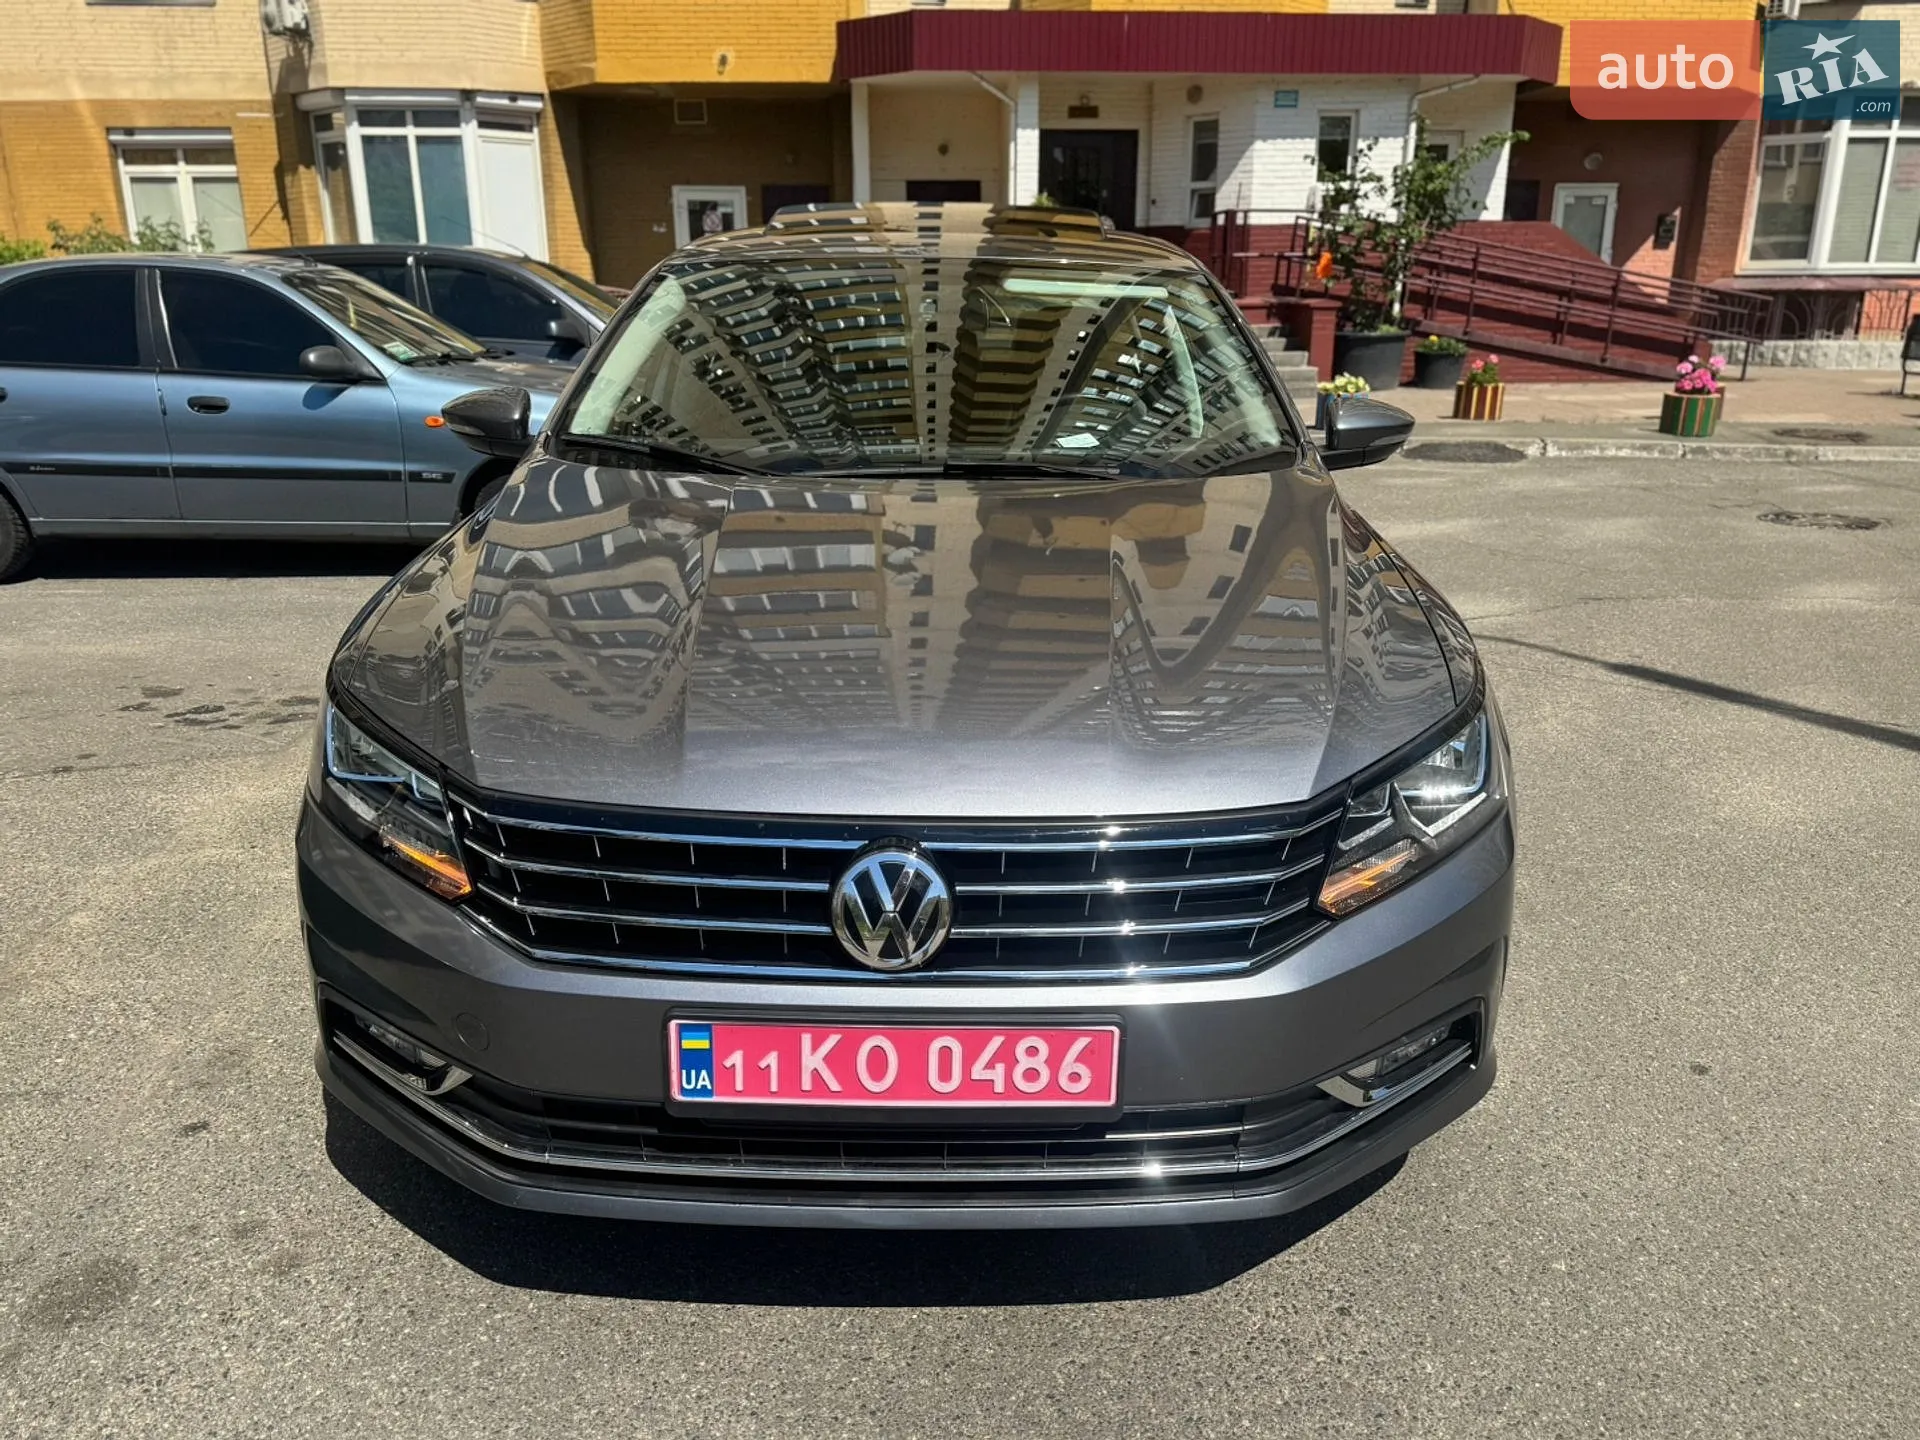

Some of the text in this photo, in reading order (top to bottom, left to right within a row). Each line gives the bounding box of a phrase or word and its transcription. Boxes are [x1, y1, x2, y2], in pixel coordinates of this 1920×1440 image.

[681, 1070, 712, 1091] UA
[800, 1032, 899, 1094] KO
[926, 1035, 1093, 1094] 0486
